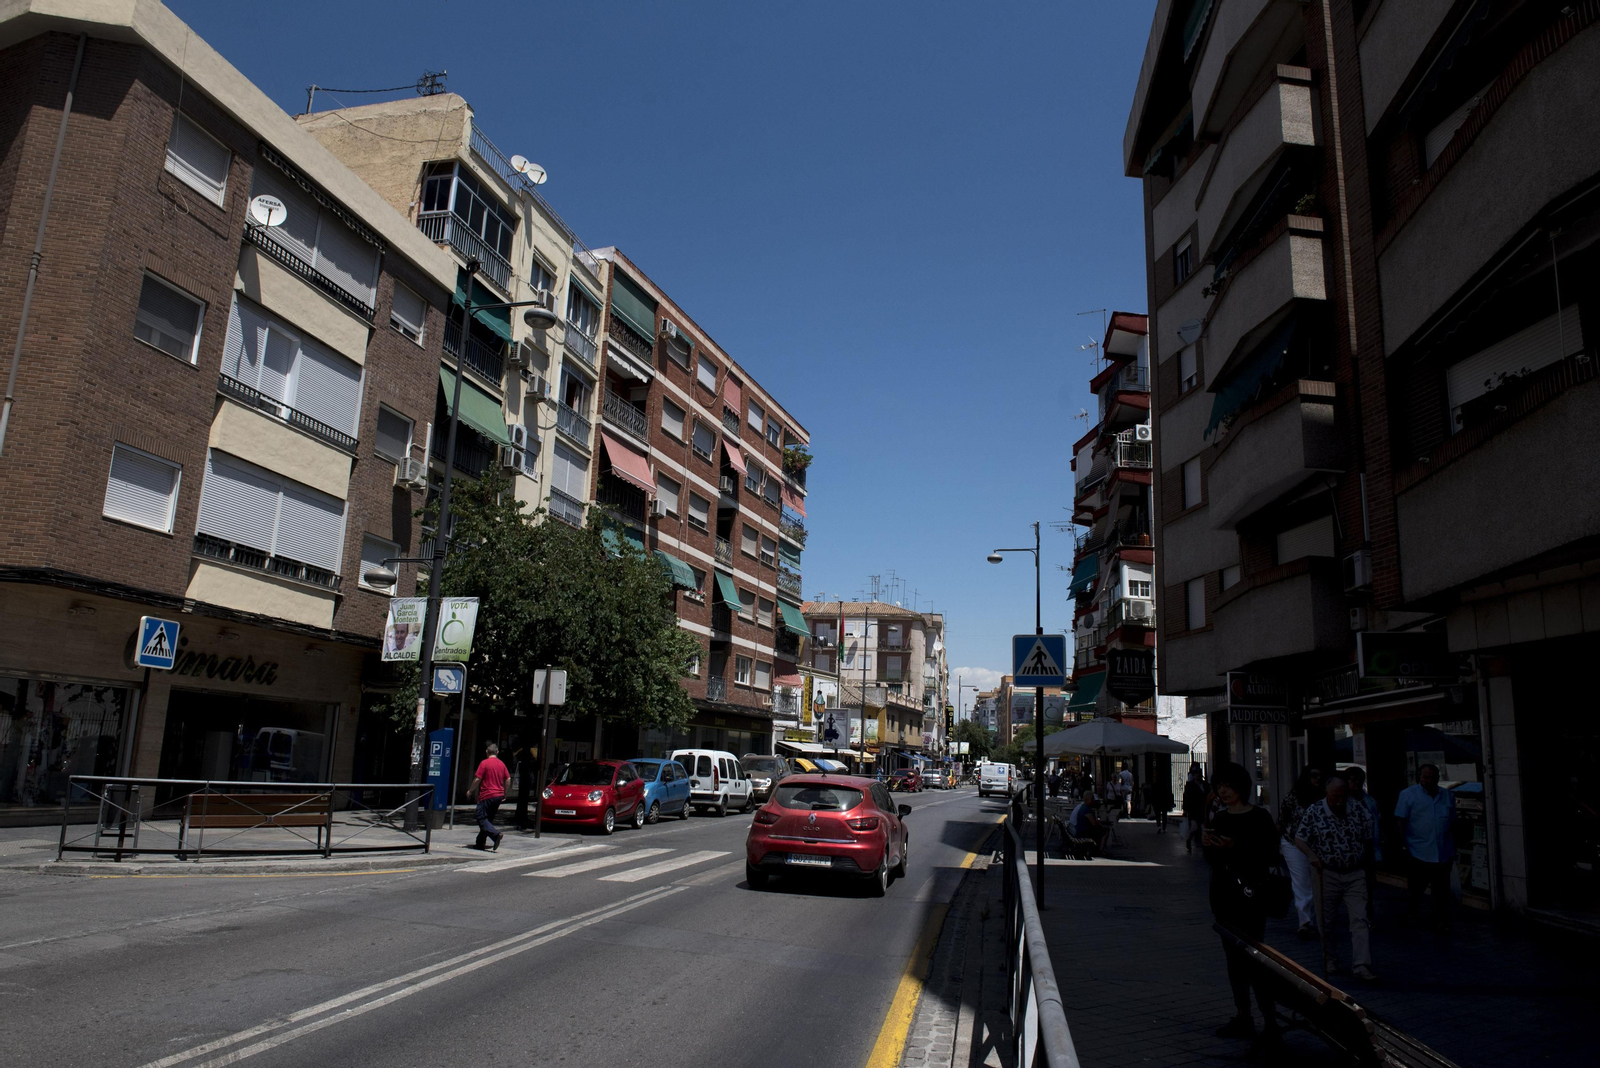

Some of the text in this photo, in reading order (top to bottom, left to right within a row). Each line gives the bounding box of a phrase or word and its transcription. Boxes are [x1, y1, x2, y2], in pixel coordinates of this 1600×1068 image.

[384, 651, 416, 660] ALCALDE
[1115, 656, 1147, 675] ZAIDA
[432, 743, 441, 754] P
[793, 854, 831, 865] 9022 HPP
